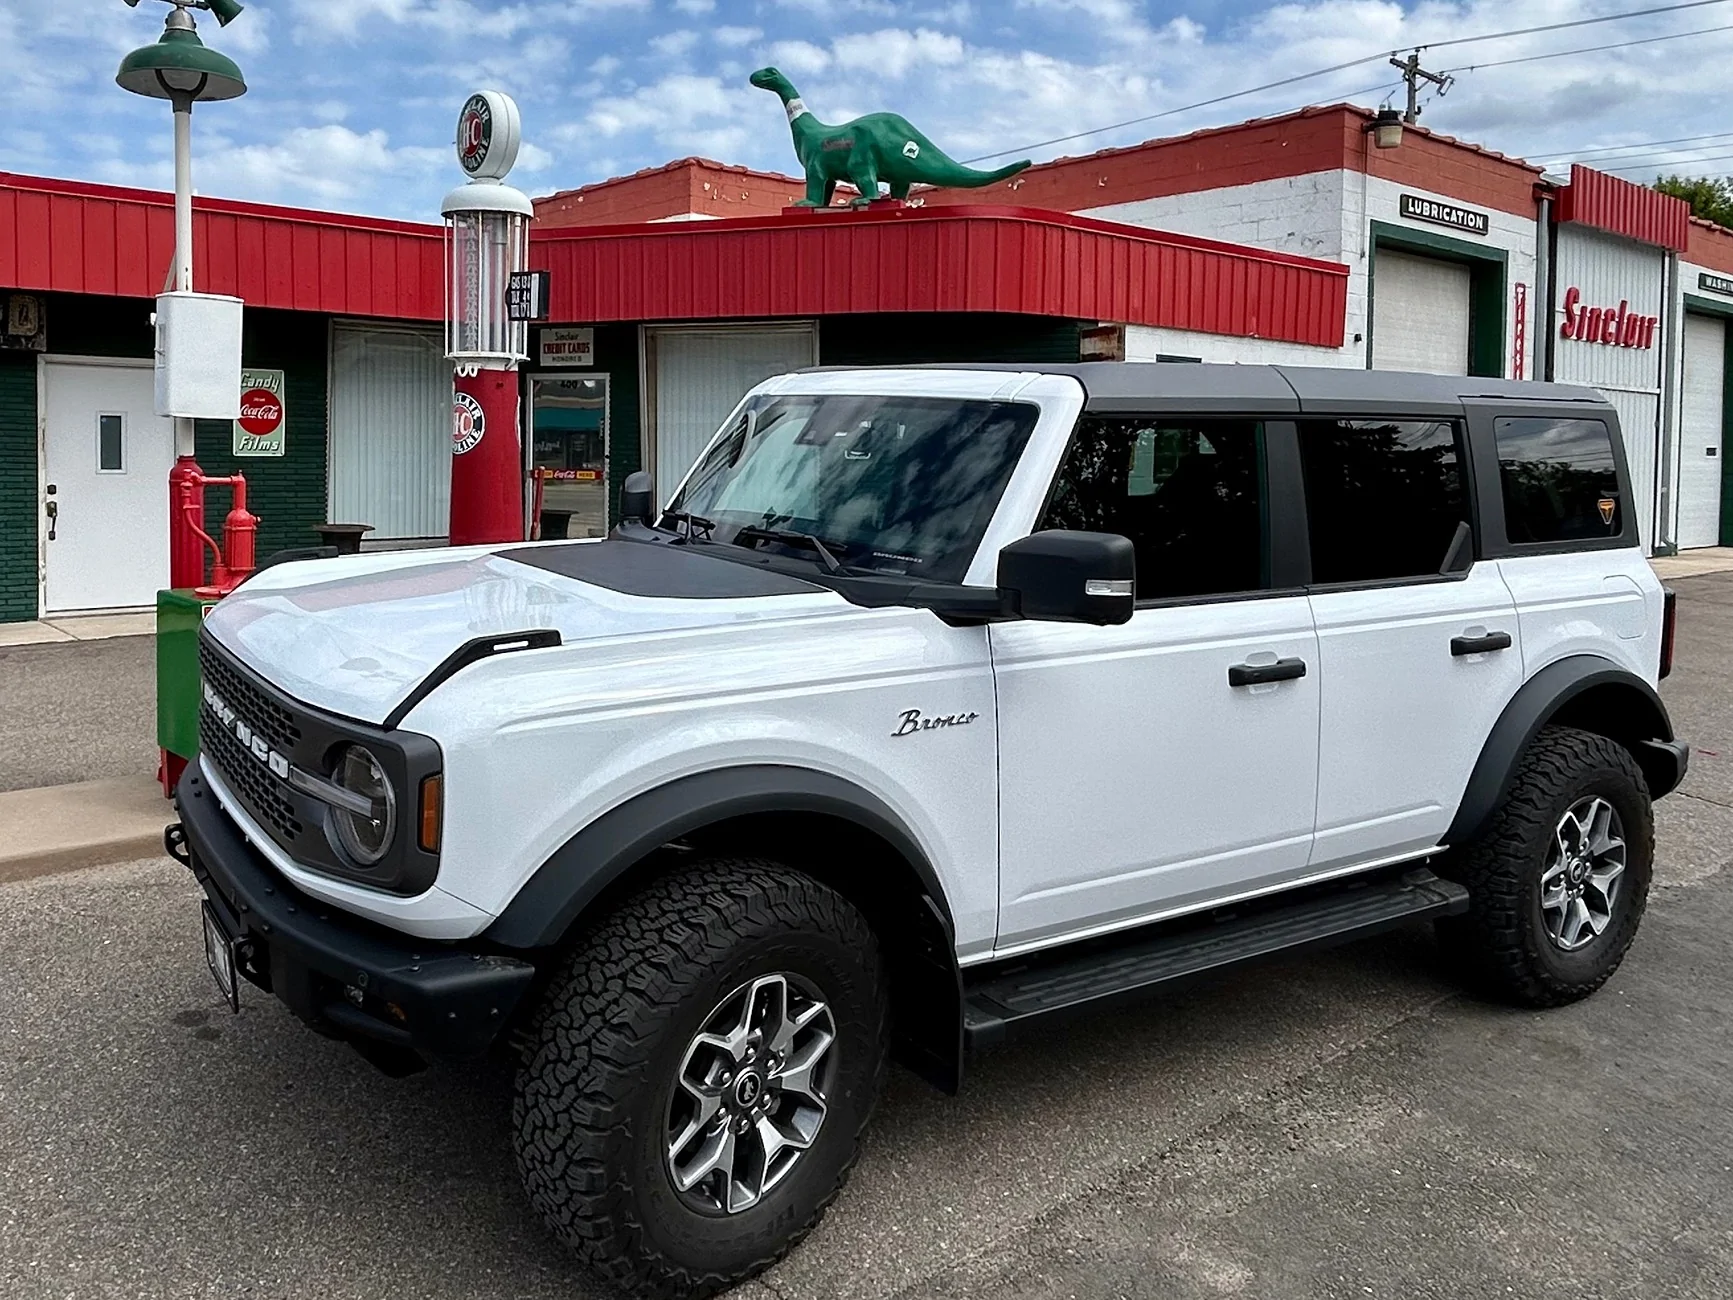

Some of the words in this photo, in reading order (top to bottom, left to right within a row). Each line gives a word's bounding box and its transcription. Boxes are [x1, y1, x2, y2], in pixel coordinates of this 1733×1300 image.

[1407, 198, 1484, 229] LUBRICATION
[1560, 286, 1658, 350] Sinclair
[568, 342, 590, 354] CARDS
[241, 373, 280, 393] Candy
[239, 435, 280, 450] Films
[890, 709, 980, 737] Bronco
